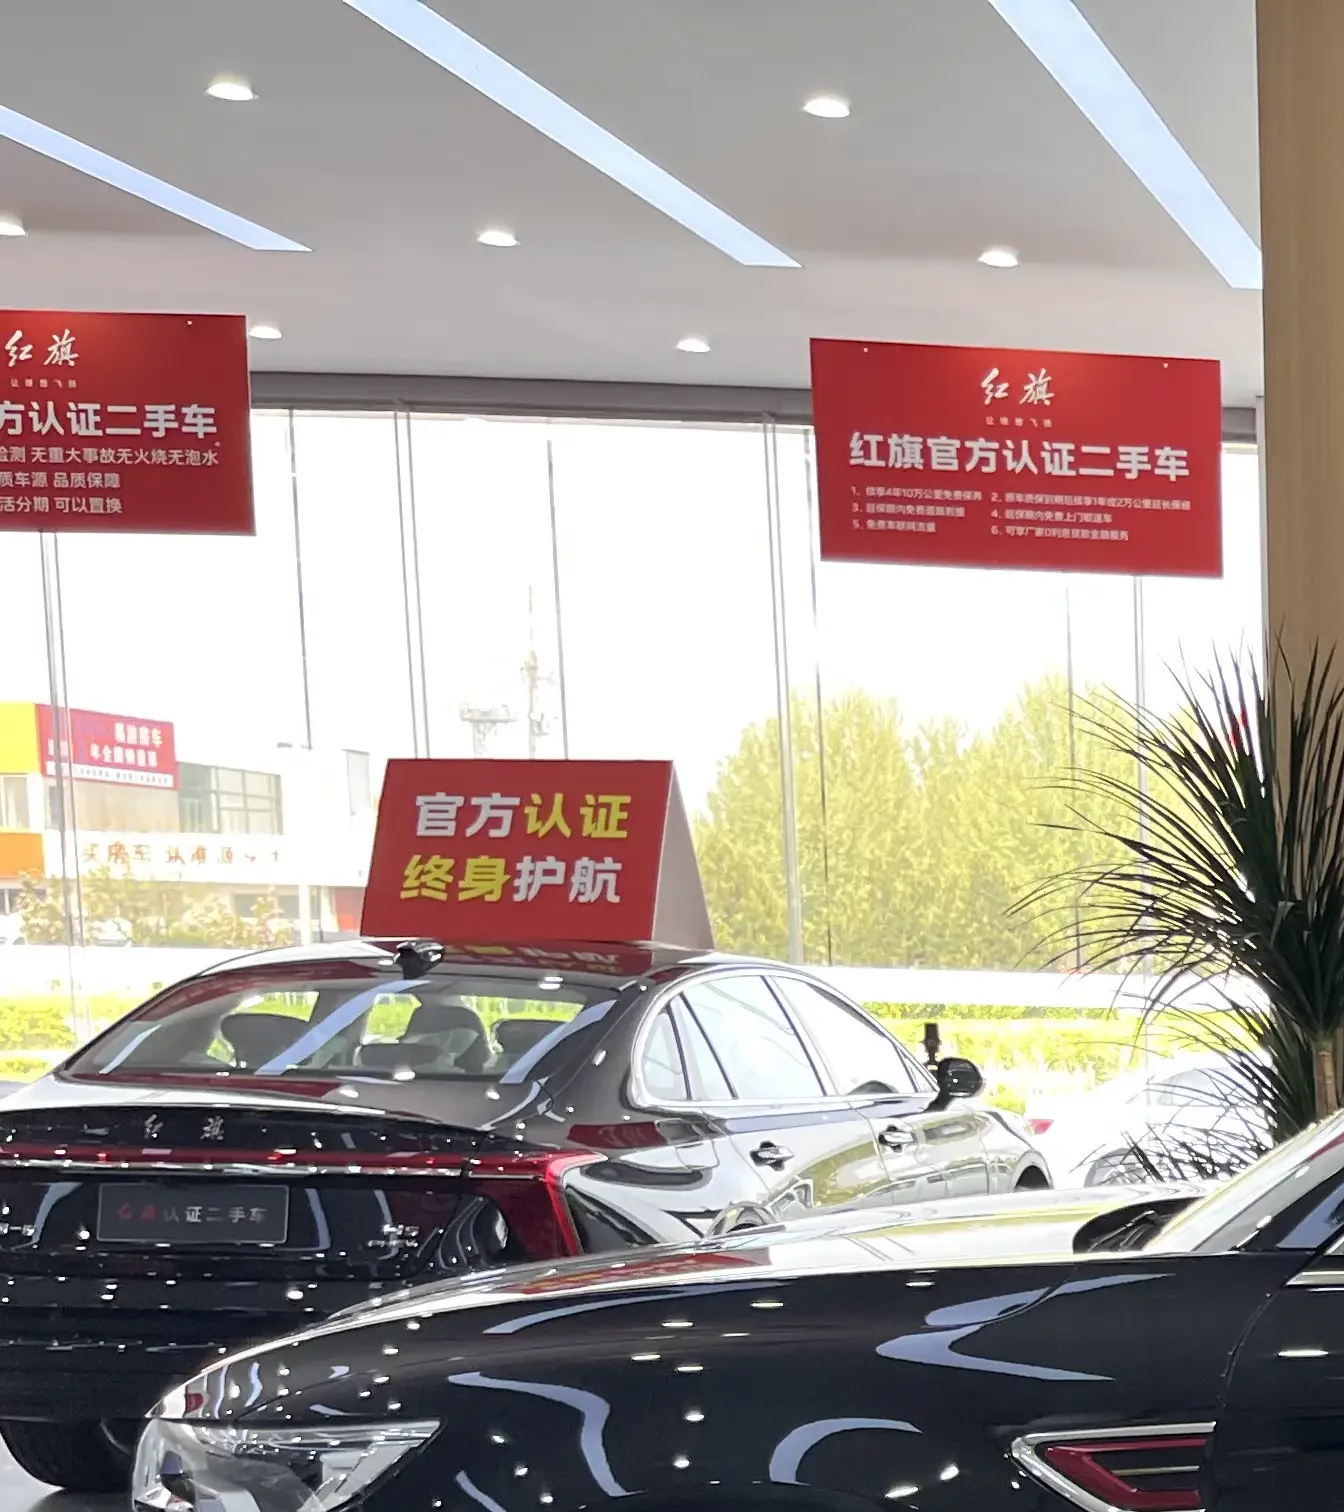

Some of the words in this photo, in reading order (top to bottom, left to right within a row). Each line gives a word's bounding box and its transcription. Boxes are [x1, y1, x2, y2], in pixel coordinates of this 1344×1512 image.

[4, 328, 80, 368] 红旗
[980, 367, 1056, 407] 红旗
[0, 400, 218, 439] 方认证二手车
[31, 446, 219, 466] 无重大事故无火烧无泡水
[848, 431, 1190, 482] 红旗官方认证二手车
[53, 471, 121, 489] 品质保障
[53, 496, 122, 514] 可以置换
[415, 791, 633, 839] 官方认证
[399, 854, 623, 904] 终身护航
